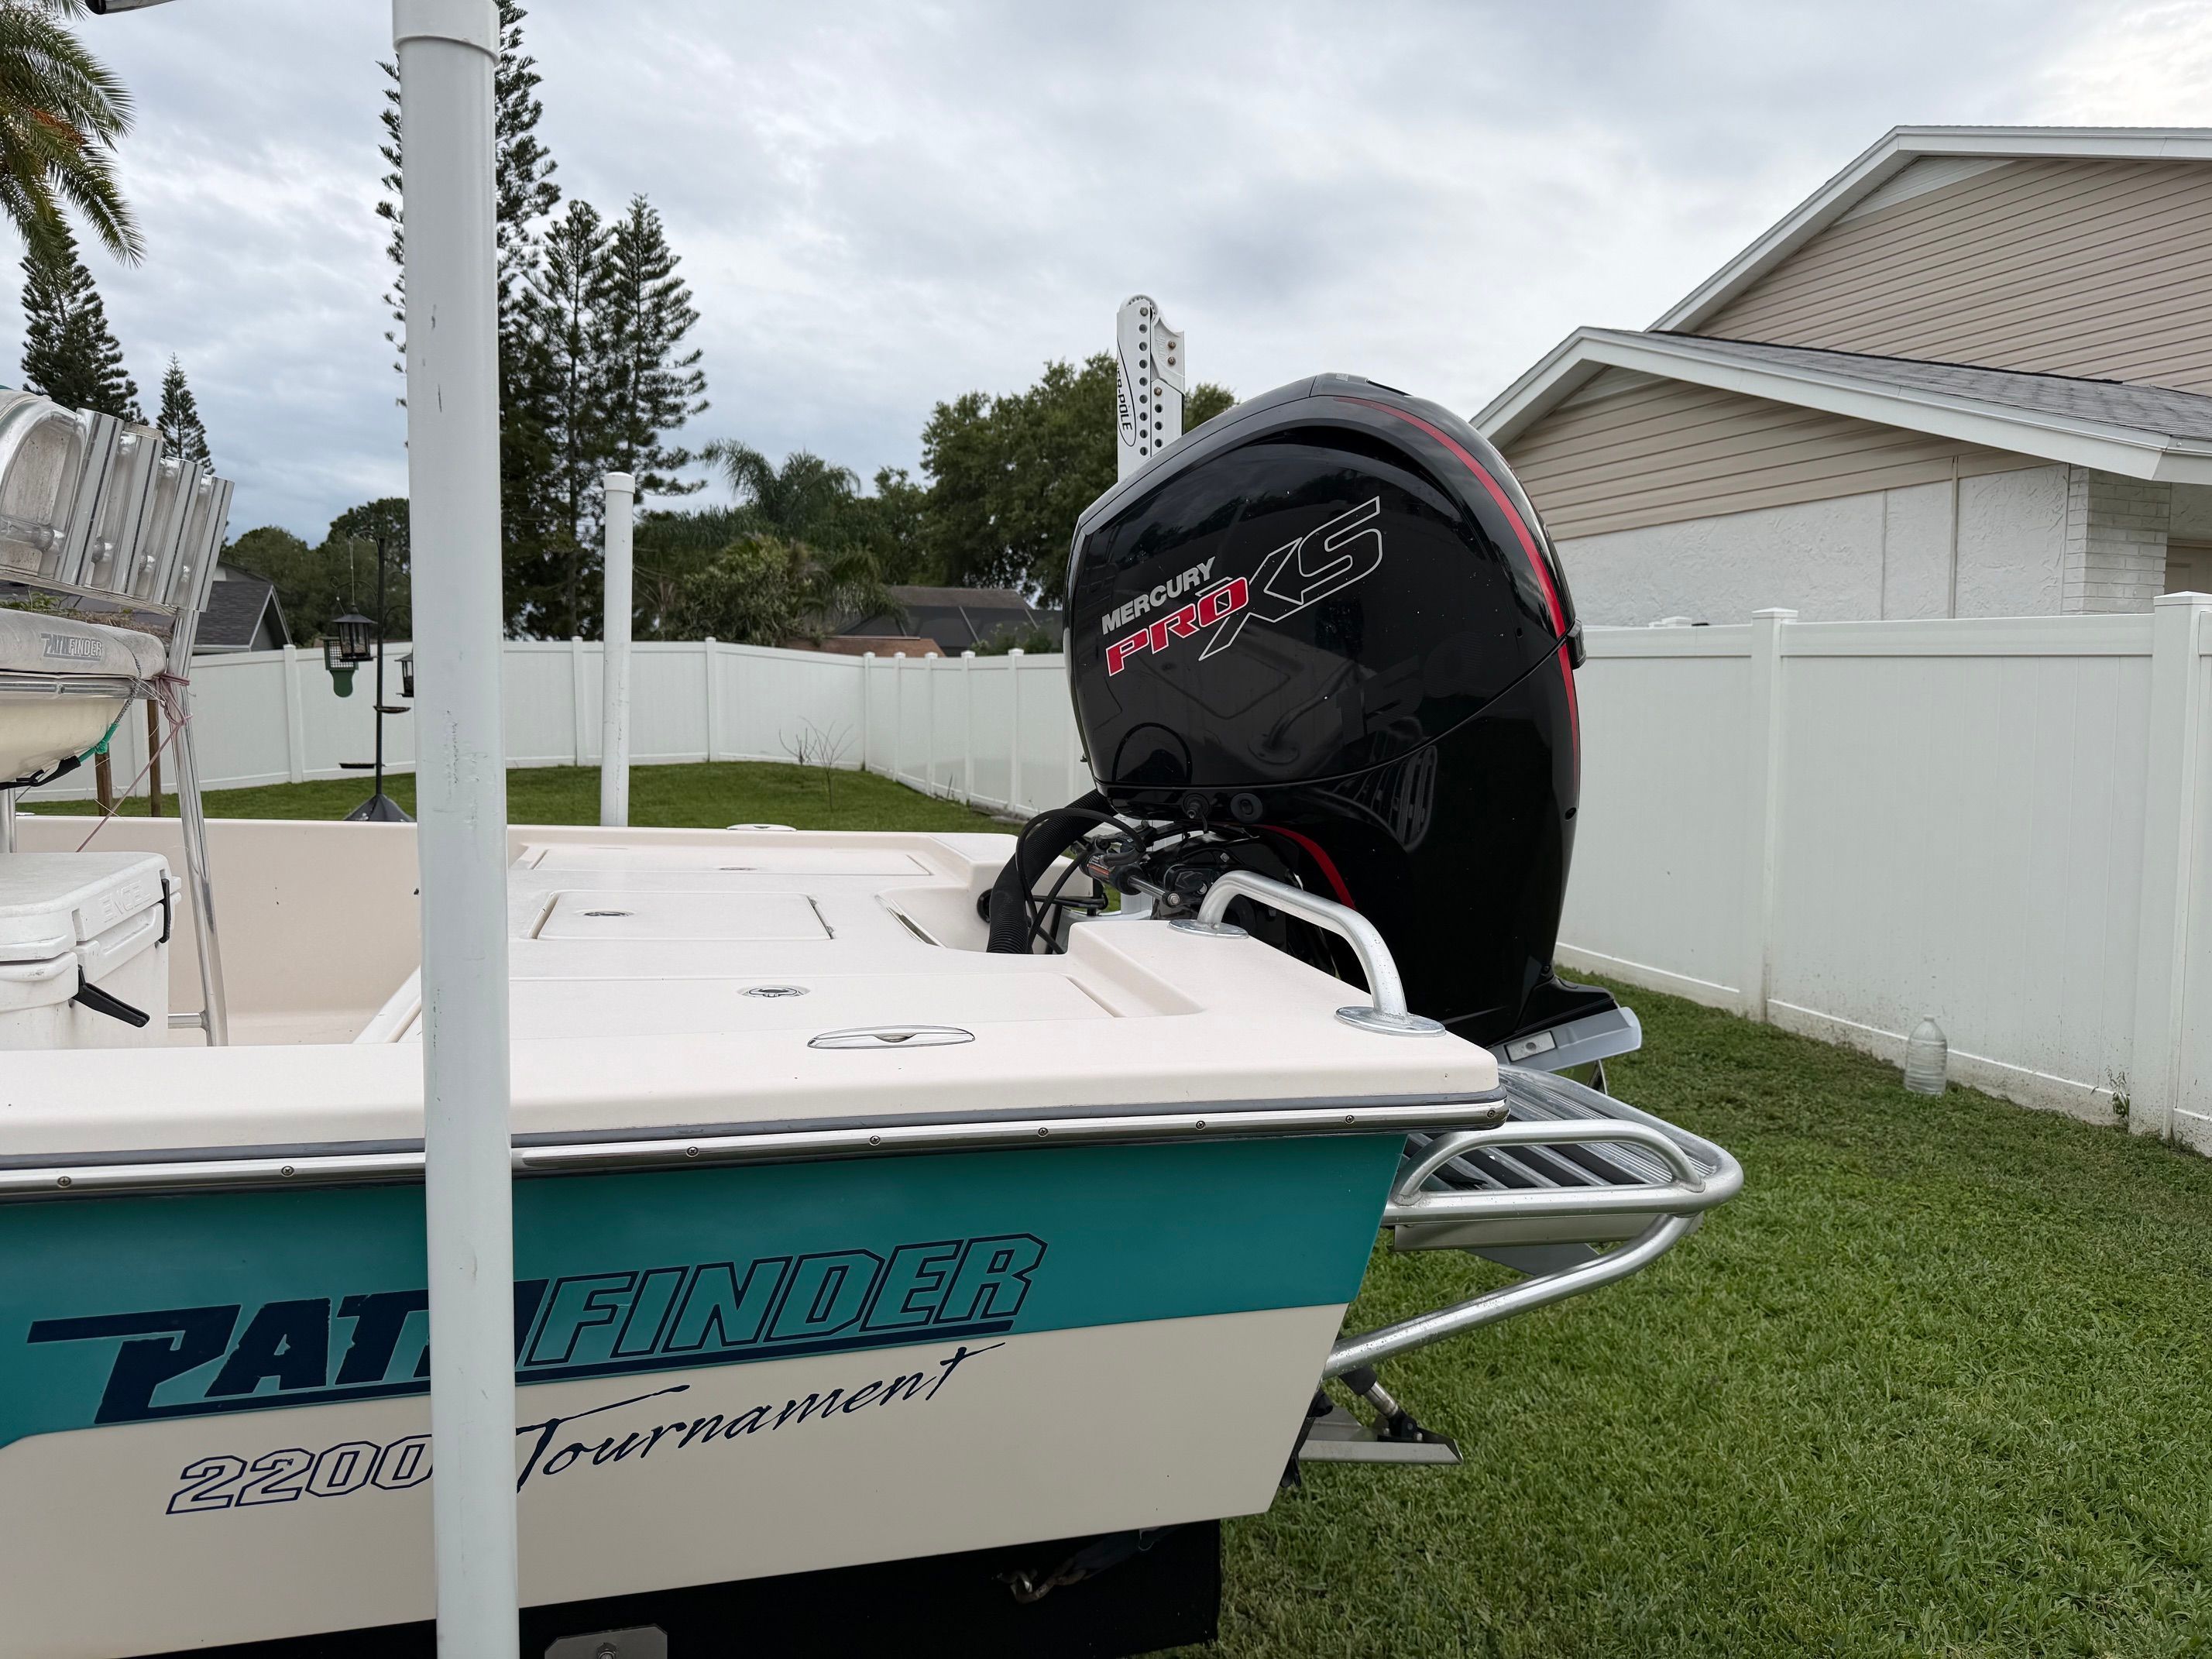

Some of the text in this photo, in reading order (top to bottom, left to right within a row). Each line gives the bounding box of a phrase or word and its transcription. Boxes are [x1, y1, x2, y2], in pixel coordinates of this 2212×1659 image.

[1101, 556, 1215, 635] MERCURY
[1106, 496, 1383, 677] PRO XS
[99, 880, 153, 923] ENGEL
[165, 1342, 1005, 1515] 2200 Tournament
